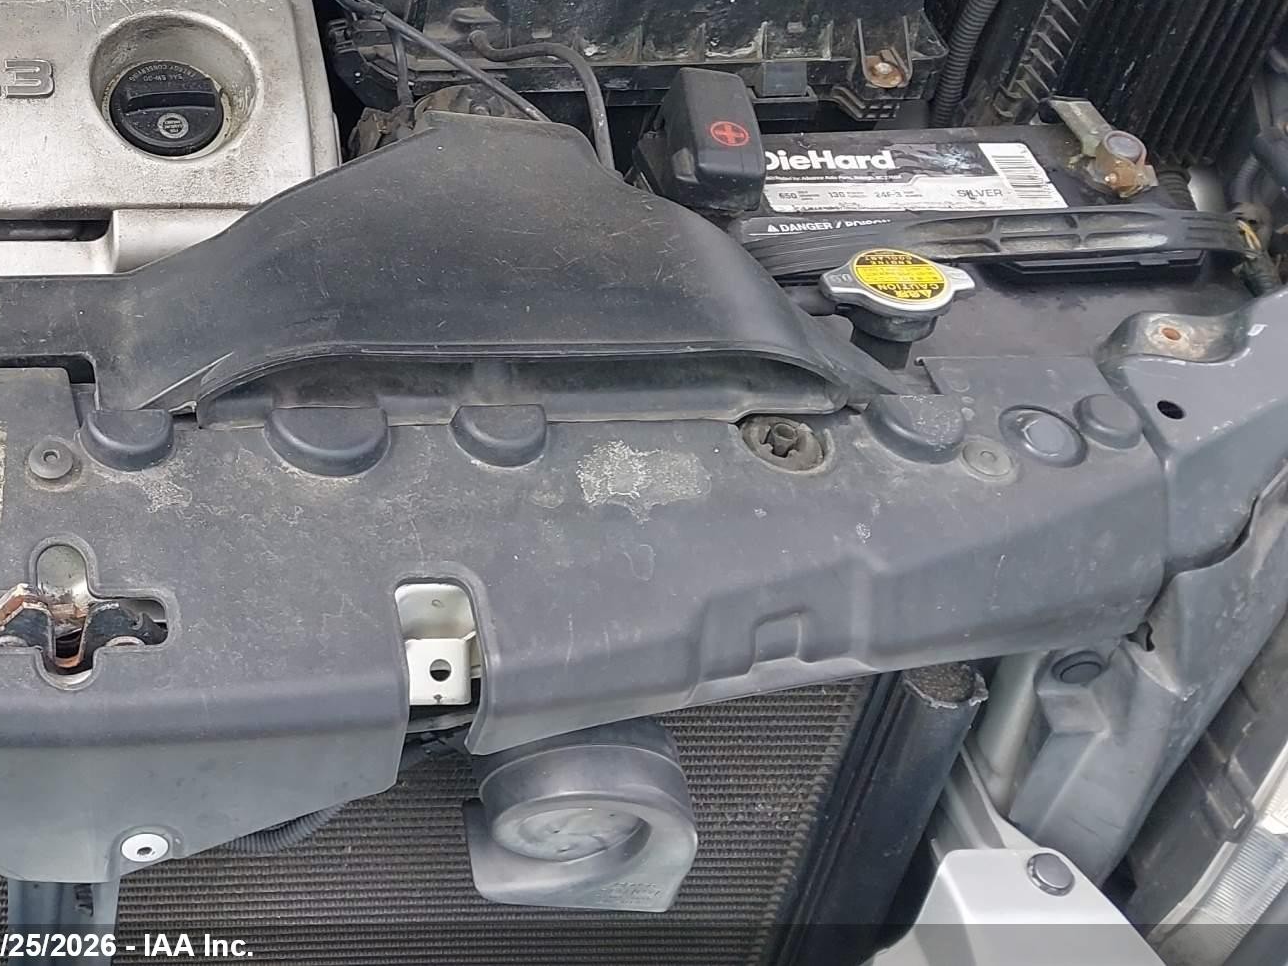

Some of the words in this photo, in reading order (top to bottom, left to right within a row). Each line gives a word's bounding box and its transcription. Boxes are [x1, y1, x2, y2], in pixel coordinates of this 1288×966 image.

[765, 150, 896, 171] DieHard
[956, 188, 1003, 199] SILVER
[779, 222, 833, 232] DANGER
[877, 283, 939, 291] CAUTION
